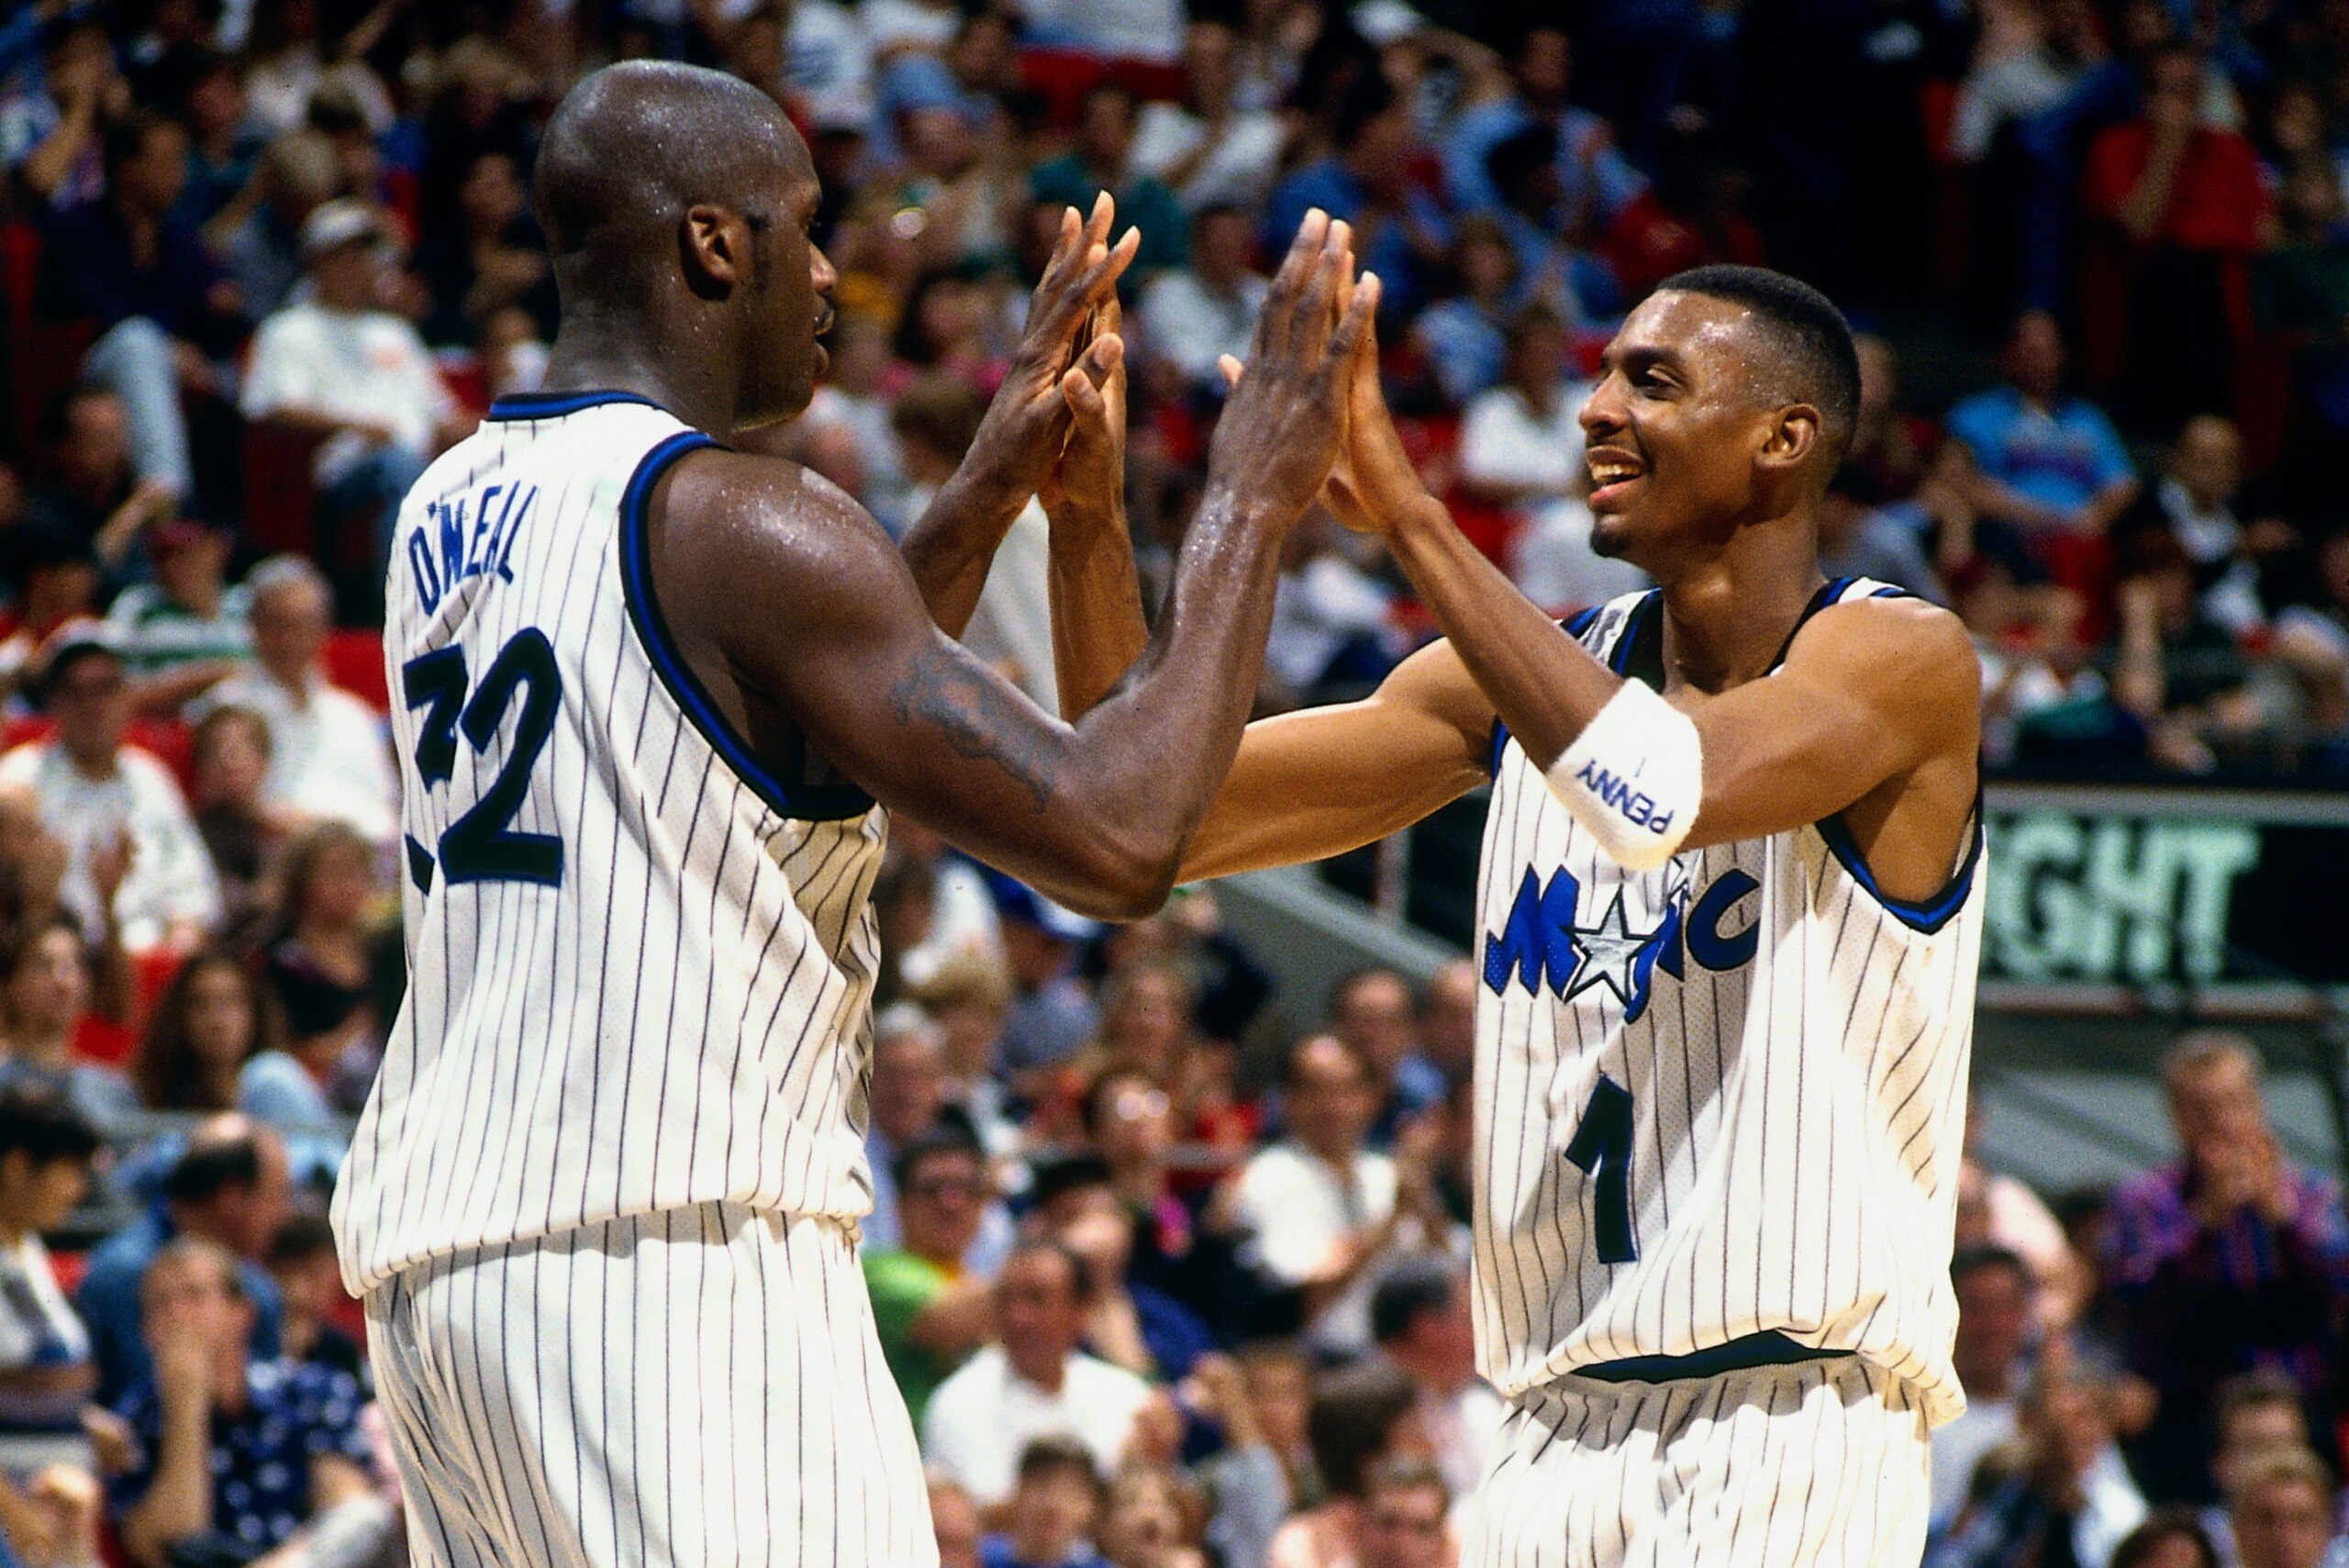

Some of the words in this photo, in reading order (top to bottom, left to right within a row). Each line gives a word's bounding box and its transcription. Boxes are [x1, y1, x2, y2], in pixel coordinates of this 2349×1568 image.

[402, 626, 563, 896] 32
[1576, 759, 1675, 835] PENNY
[1982, 817, 2262, 984] GHT
[1564, 1073, 1638, 1264] 1
